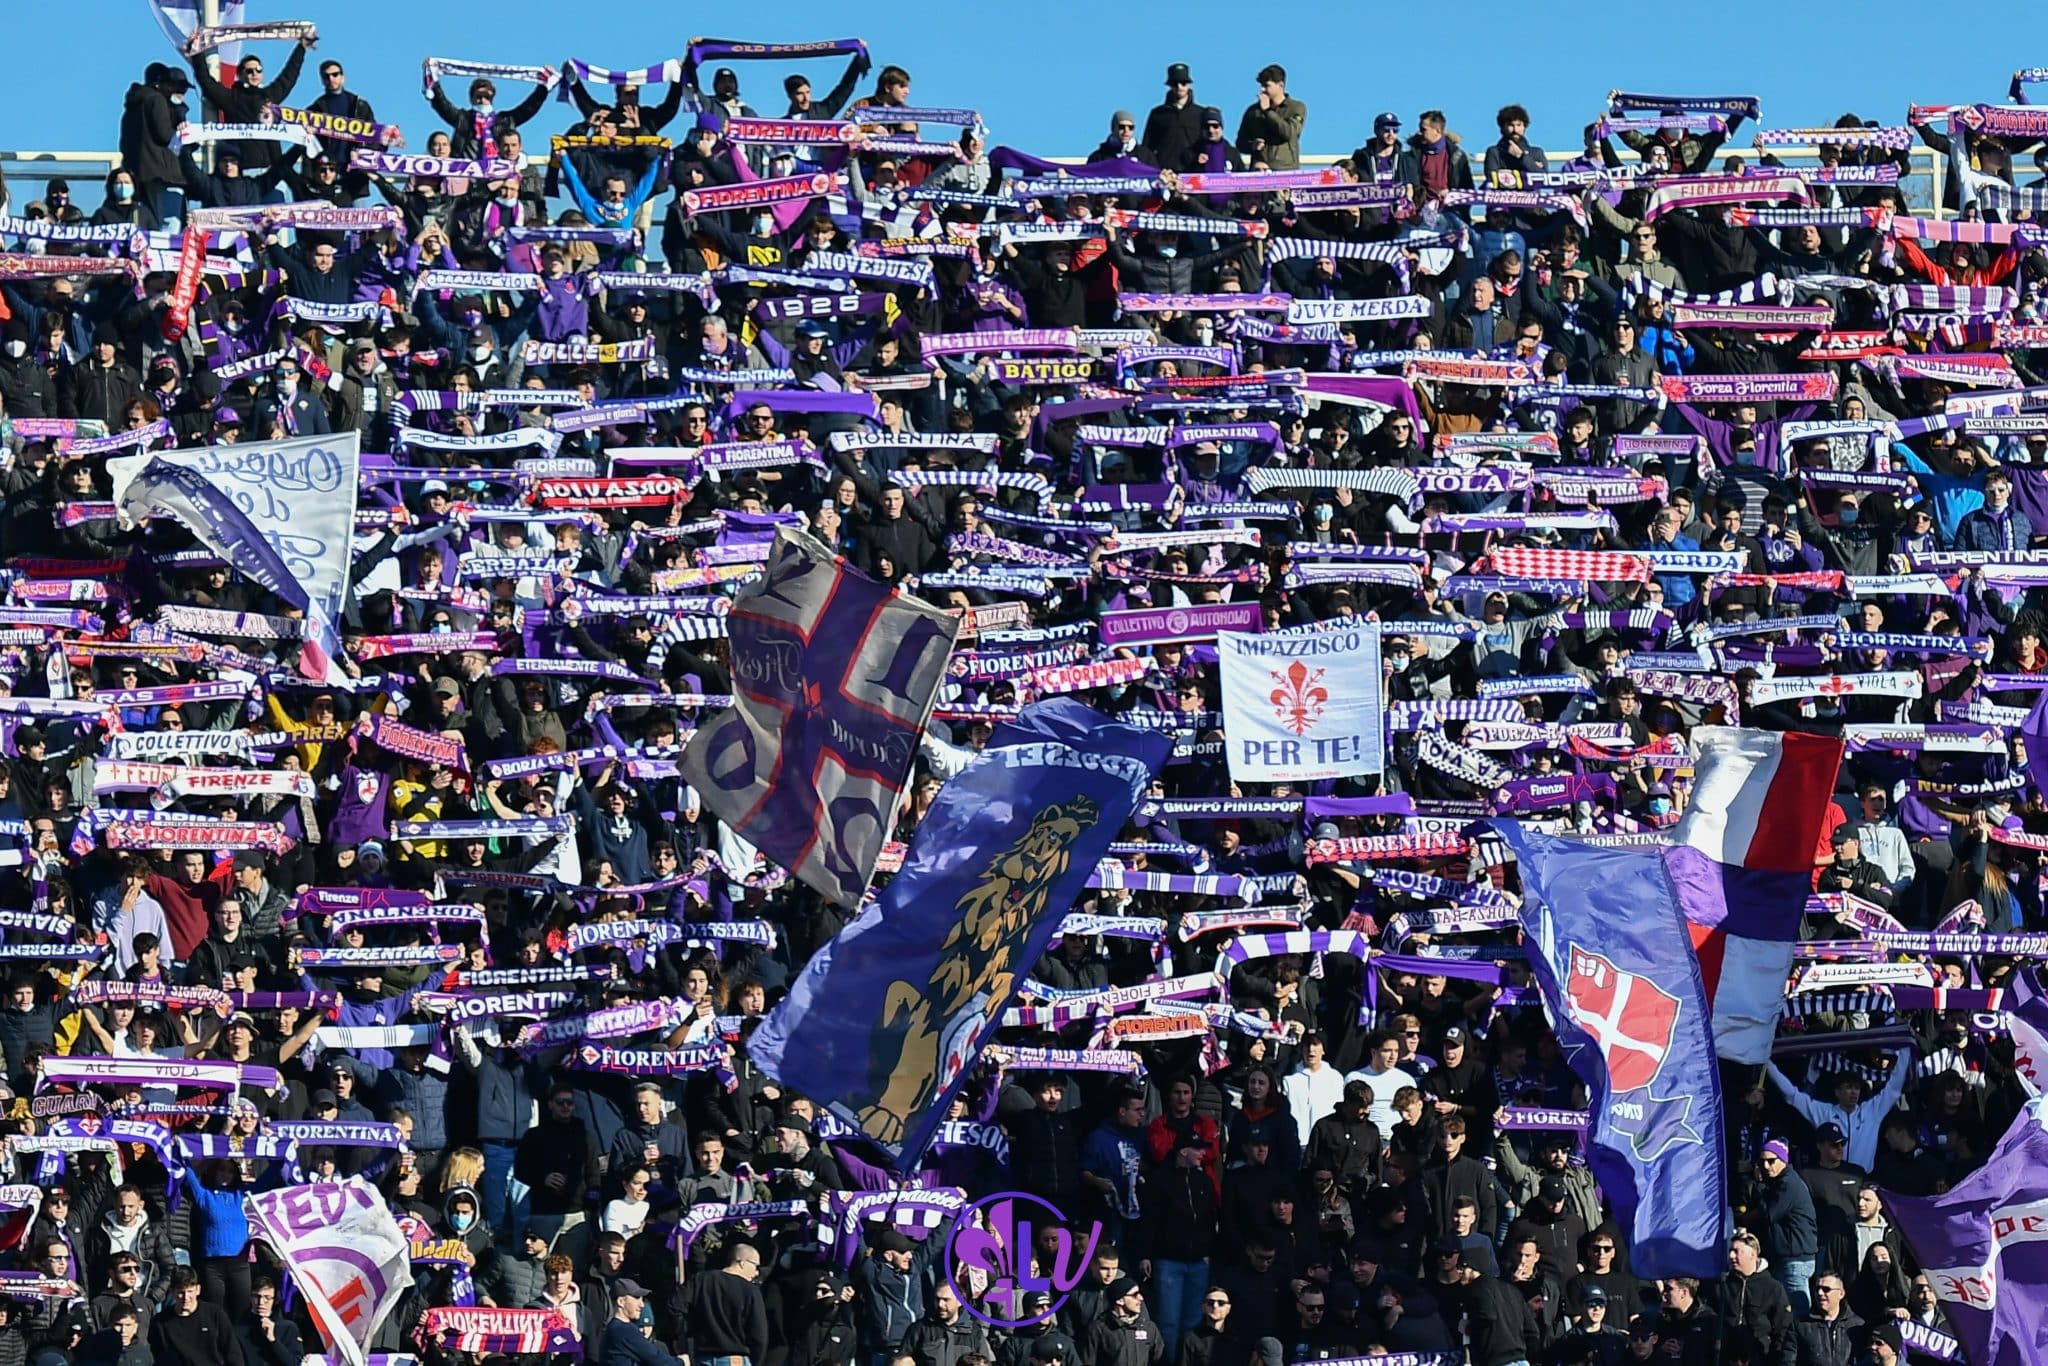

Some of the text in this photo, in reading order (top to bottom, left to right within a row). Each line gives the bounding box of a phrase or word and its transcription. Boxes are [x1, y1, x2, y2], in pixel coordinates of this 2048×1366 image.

[731, 41, 766, 53] OLD
[279, 106, 375, 138] BATIGOL
[728, 122, 840, 141] FIORENTINA
[382, 153, 484, 178] VIOLA
[1836, 166, 1880, 181] VIOLA
[703, 180, 812, 209] FIORENTINA
[1680, 180, 1782, 199] FIORENTINA
[1757, 207, 1862, 225] FIORENTINA
[766, 294, 861, 318] 1926
[1293, 298, 1424, 319] JUVE MERDA
[1695, 309, 1812, 322] VIOLA FOREVER
[1301, 323, 1343, 340] STOR
[845, 432, 979, 448] FIORENTINA
[1183, 426, 1259, 441] FIORENTINA
[1622, 439, 1689, 450] FIORENTINA
[725, 445, 795, 463] FIORENTINA
[523, 459, 593, 475] FIORENTI
[1183, 499, 1291, 518] ACF FIORENTINA
[586, 599, 635, 614] VINCI
[1106, 609, 1251, 634] COLLETTIVO AUTONOMO
[1236, 632, 1361, 658] IMPAZZISCO
[1840, 632, 1970, 654] FIORENTINA
[515, 659, 600, 674] ETERNAMENTE
[967, 645, 1077, 674] FIORENTINA
[1060, 660, 1142, 684] FIORENTINA
[1772, 674, 1899, 698] FORZA VIOLA
[97, 691, 153, 704] RAS
[135, 734, 231, 751] COLLETTIVO
[377, 721, 459, 761] FIORENTINA
[1878, 732, 1972, 745] FIORENTINA
[1242, 735, 1361, 767] PER TE!
[187, 772, 274, 788] FIRENZE
[1530, 783, 1566, 797] Firenze
[1163, 800, 1303, 814] GRUPPO PINIASPOR
[145, 825, 259, 844] FIORENTINA
[1339, 832, 1455, 852] FIORENTINA
[1584, 831, 1666, 848] FIORENTINA
[318, 890, 360, 905] Firenze
[1935, 931, 1982, 952] VANTO
[1986, 934, 1998, 952] E
[326, 945, 436, 962] FIORENTINA
[456, 965, 589, 986] FIORENTINA
[137, 981, 166, 995] ALLA
[1156, 976, 1186, 994] ALE
[601, 1047, 722, 1069] FIORENTINA
[1050, 1050, 1077, 1066] ALLA
[84, 1062, 201, 1079] ALE VIOLA
[147, 1103, 208, 1113] FIORENTINA
[1514, 1111, 1591, 1126] FIOREN
[277, 1125, 394, 1144] FIORENTINA
